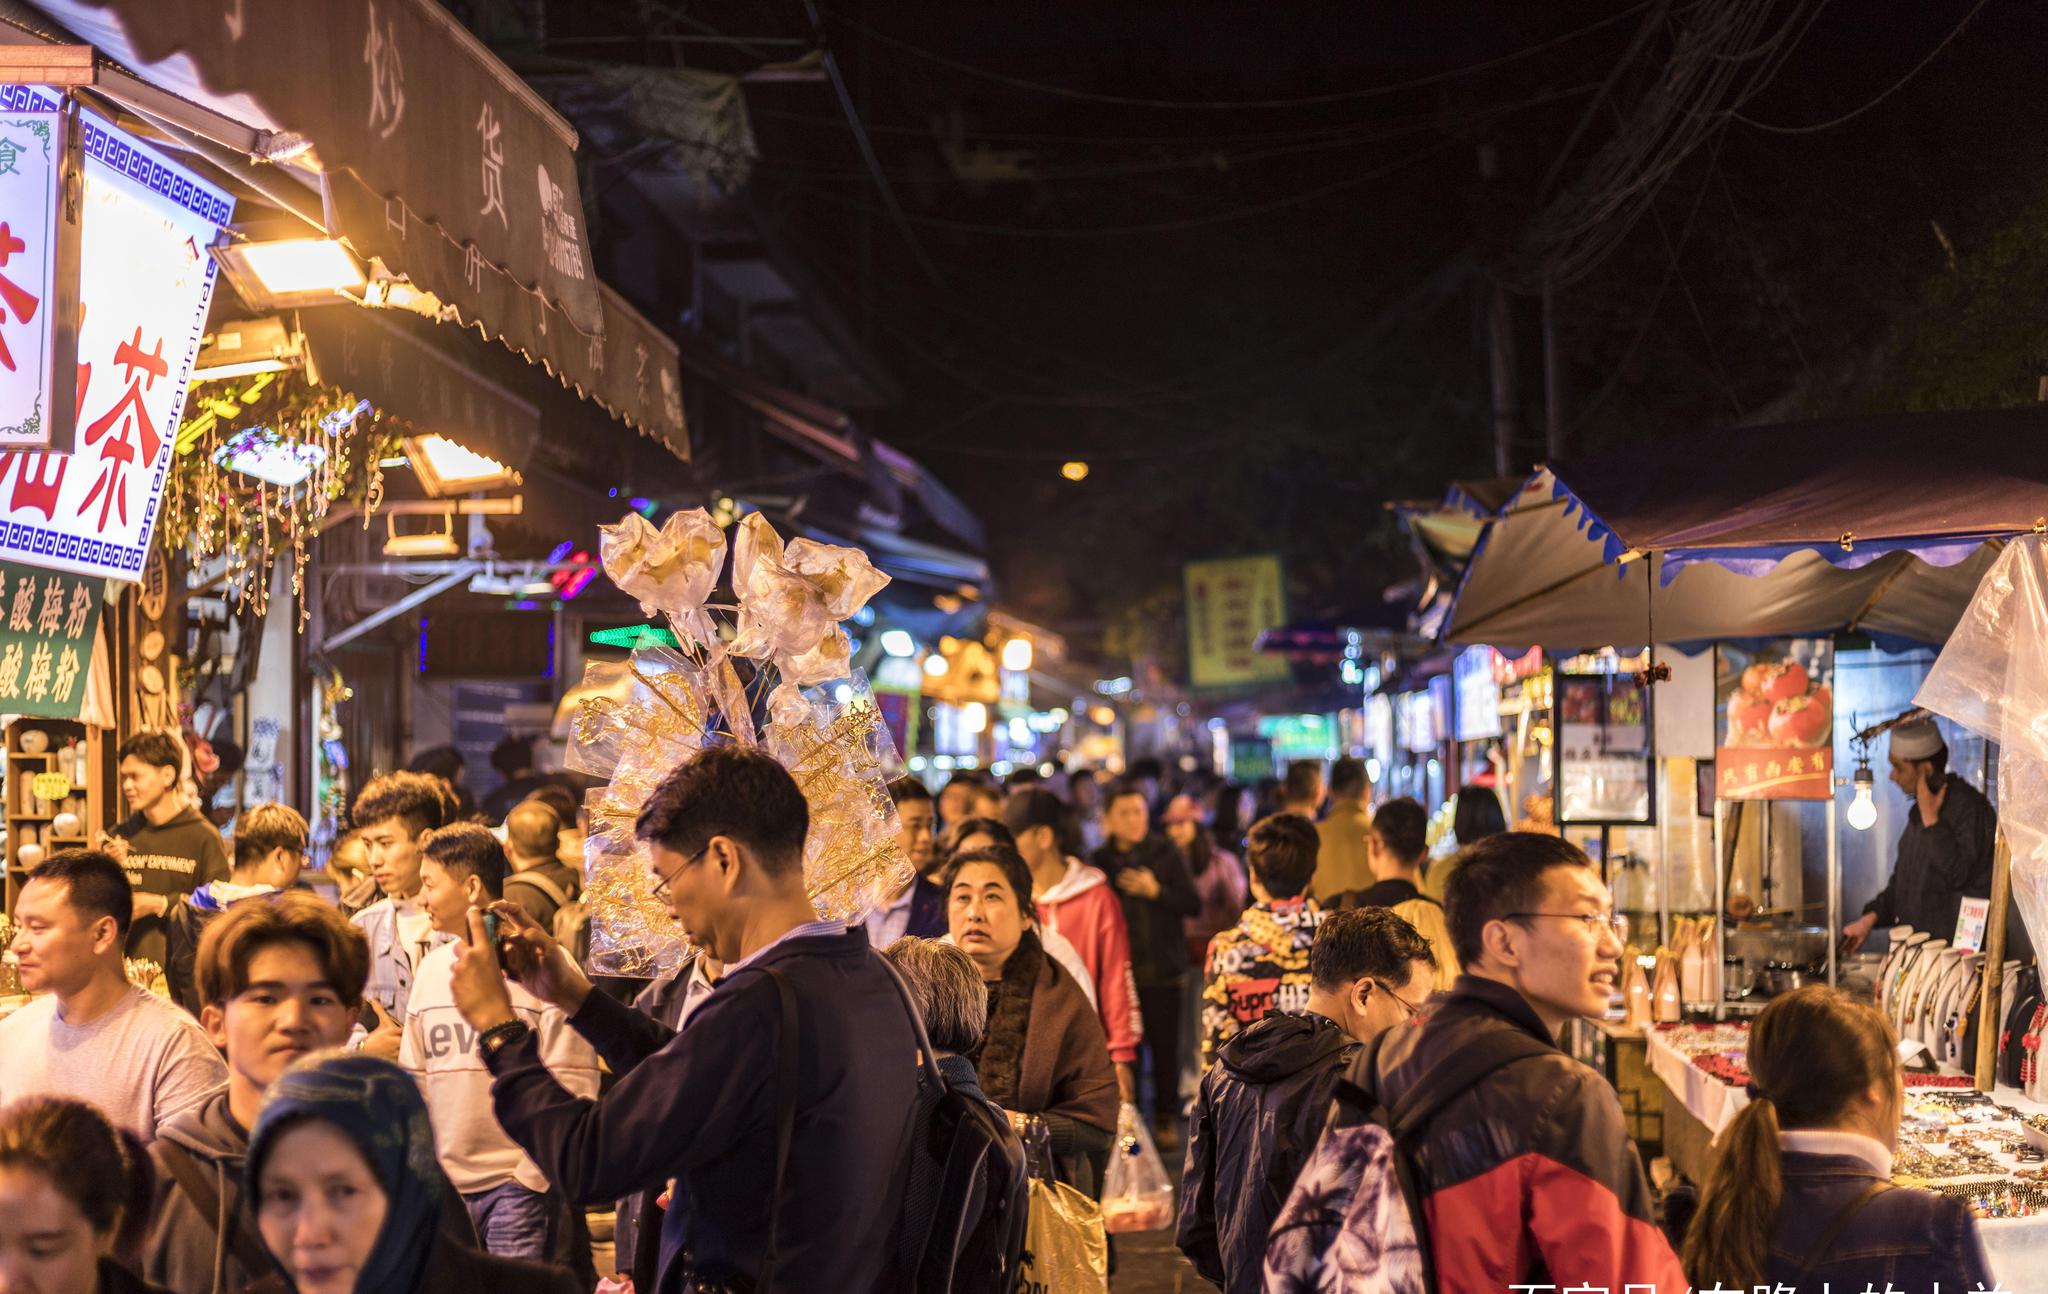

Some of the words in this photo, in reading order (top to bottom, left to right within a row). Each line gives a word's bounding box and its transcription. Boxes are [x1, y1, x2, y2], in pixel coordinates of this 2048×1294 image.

[0, 570, 92, 639] 酸梅粉
[422, 1023, 480, 1059] Lev
